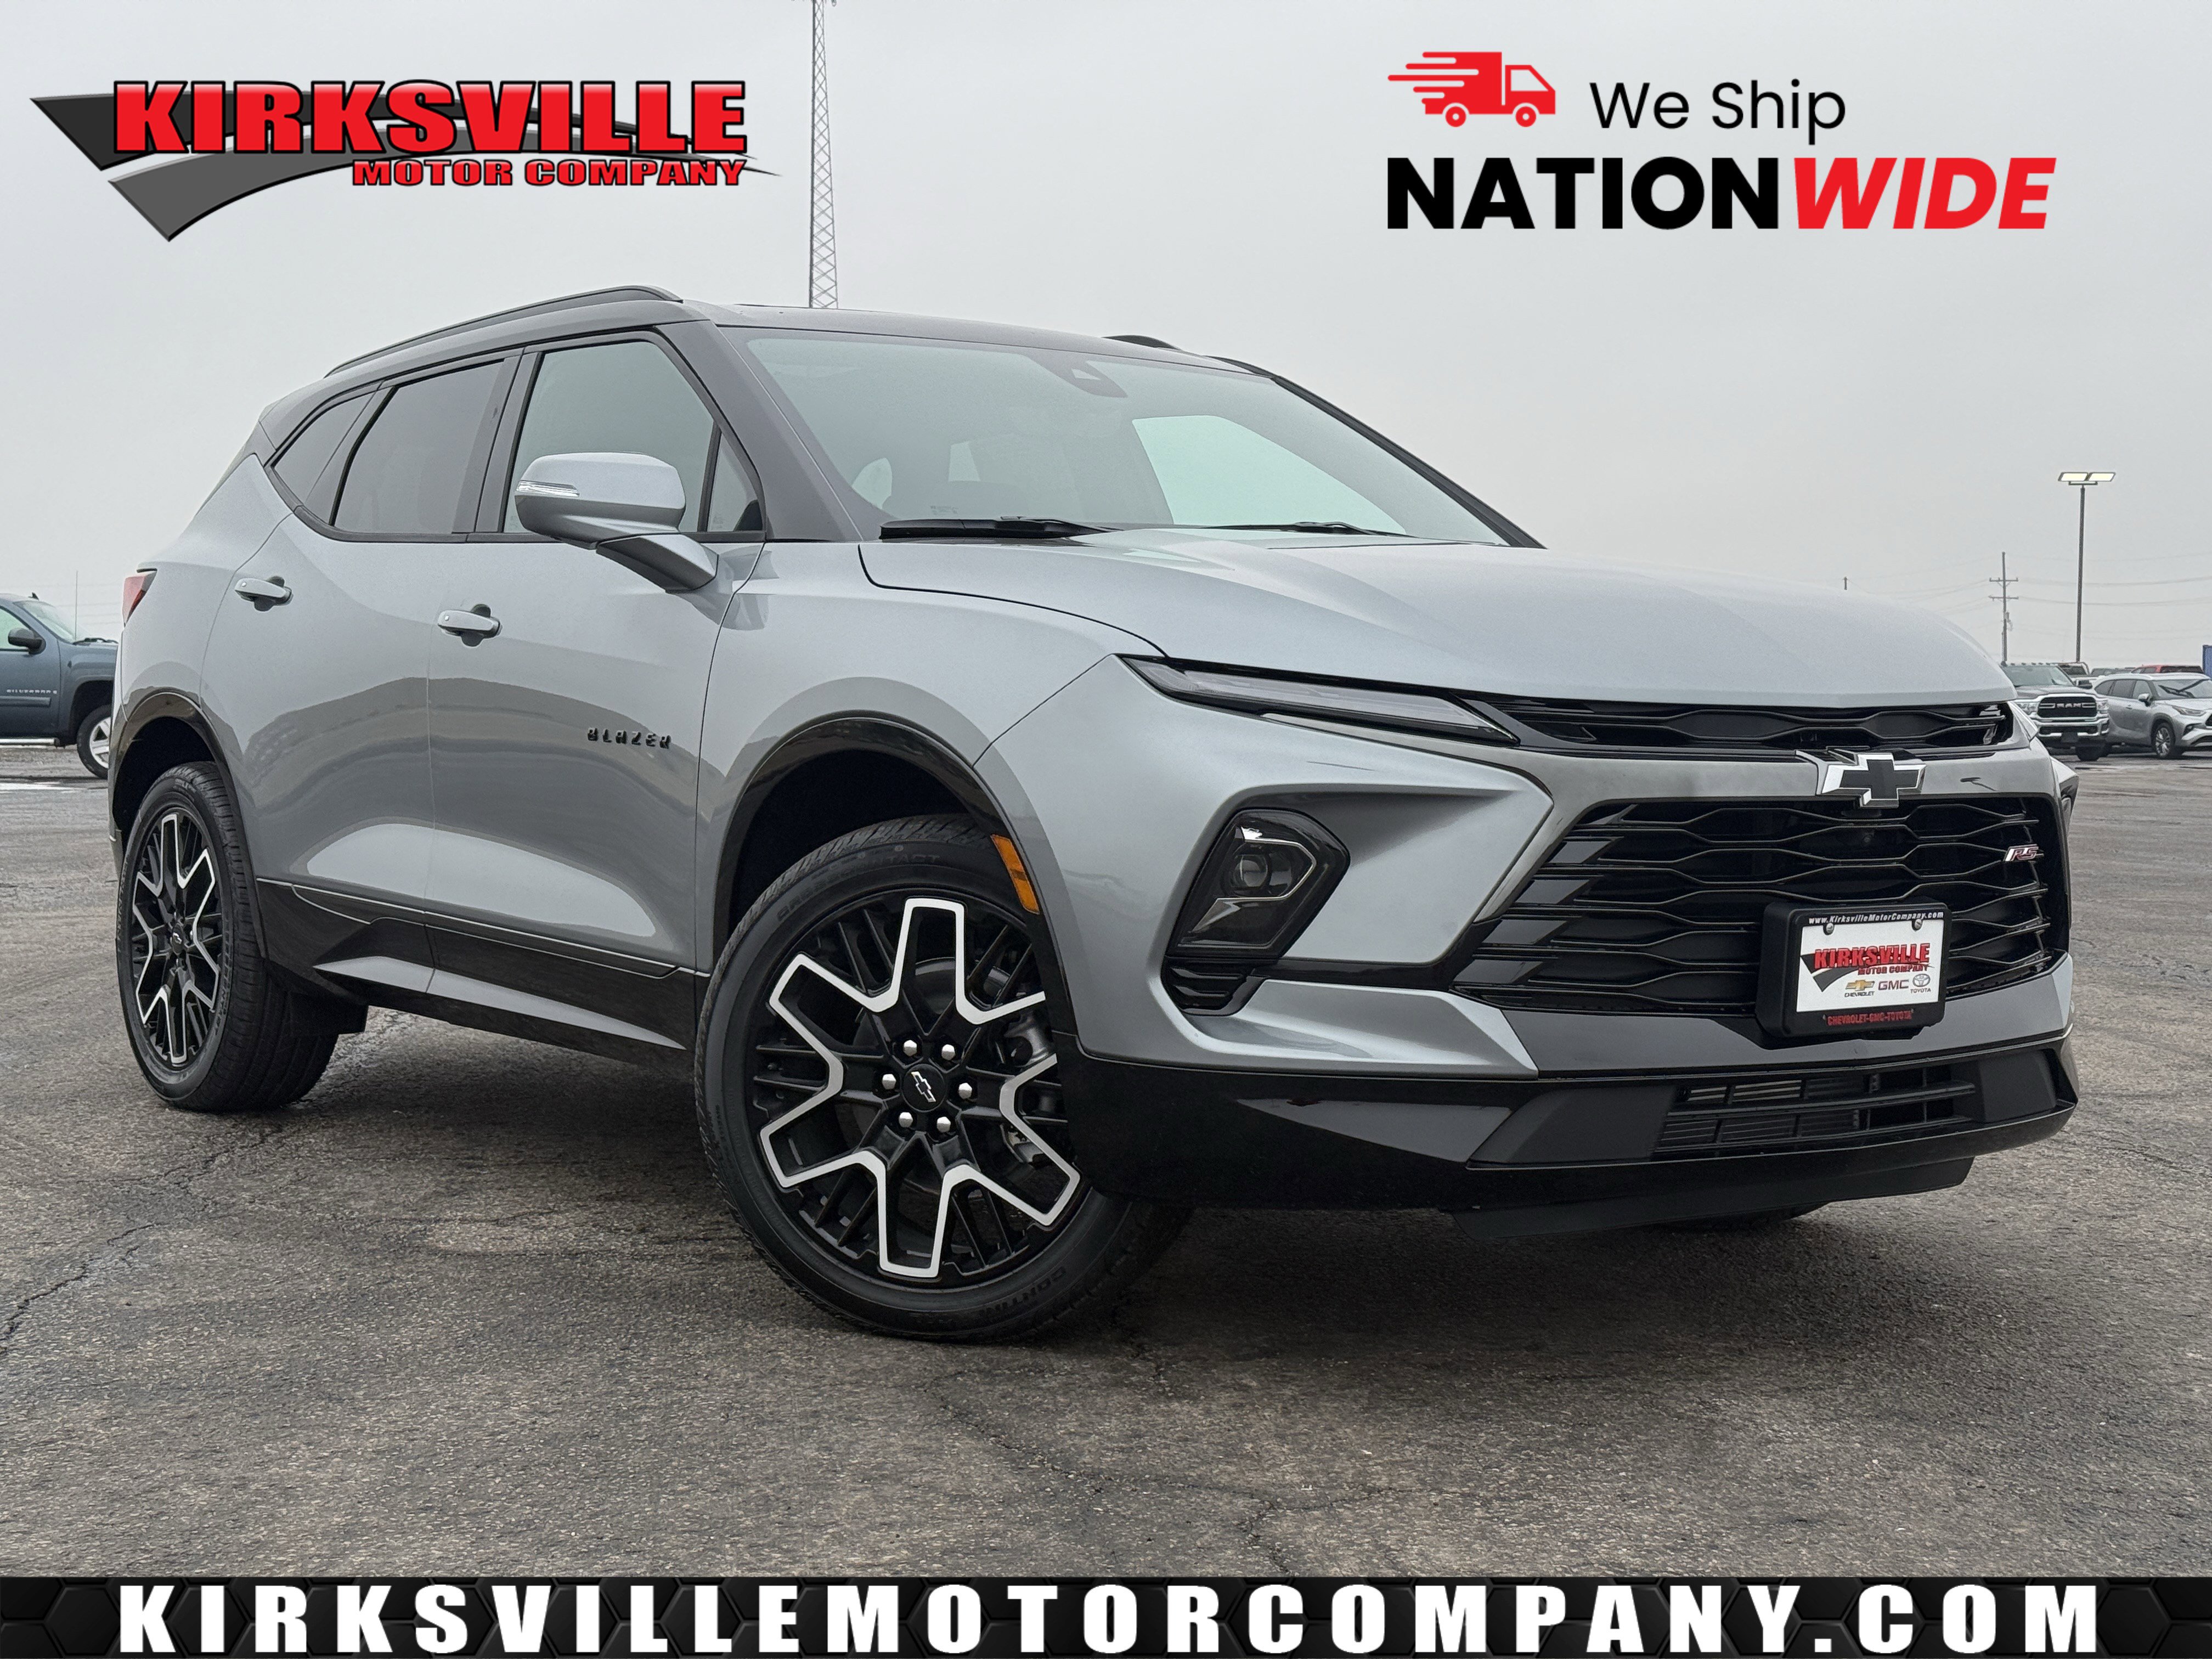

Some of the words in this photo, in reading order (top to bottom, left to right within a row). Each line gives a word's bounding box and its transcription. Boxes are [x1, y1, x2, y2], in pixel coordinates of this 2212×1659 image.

[587, 727, 672, 749] BLAZER
[2004, 843, 2039, 862] RS
[1809, 911, 1944, 924] www.KirksvilleMotorCompany.com
[1814, 943, 1931, 969] KIRKSVILLE
[1858, 967, 1888, 975] MOTOR
[1889, 964, 1928, 974] COMPANY
[1878, 979, 1909, 991] GMC
